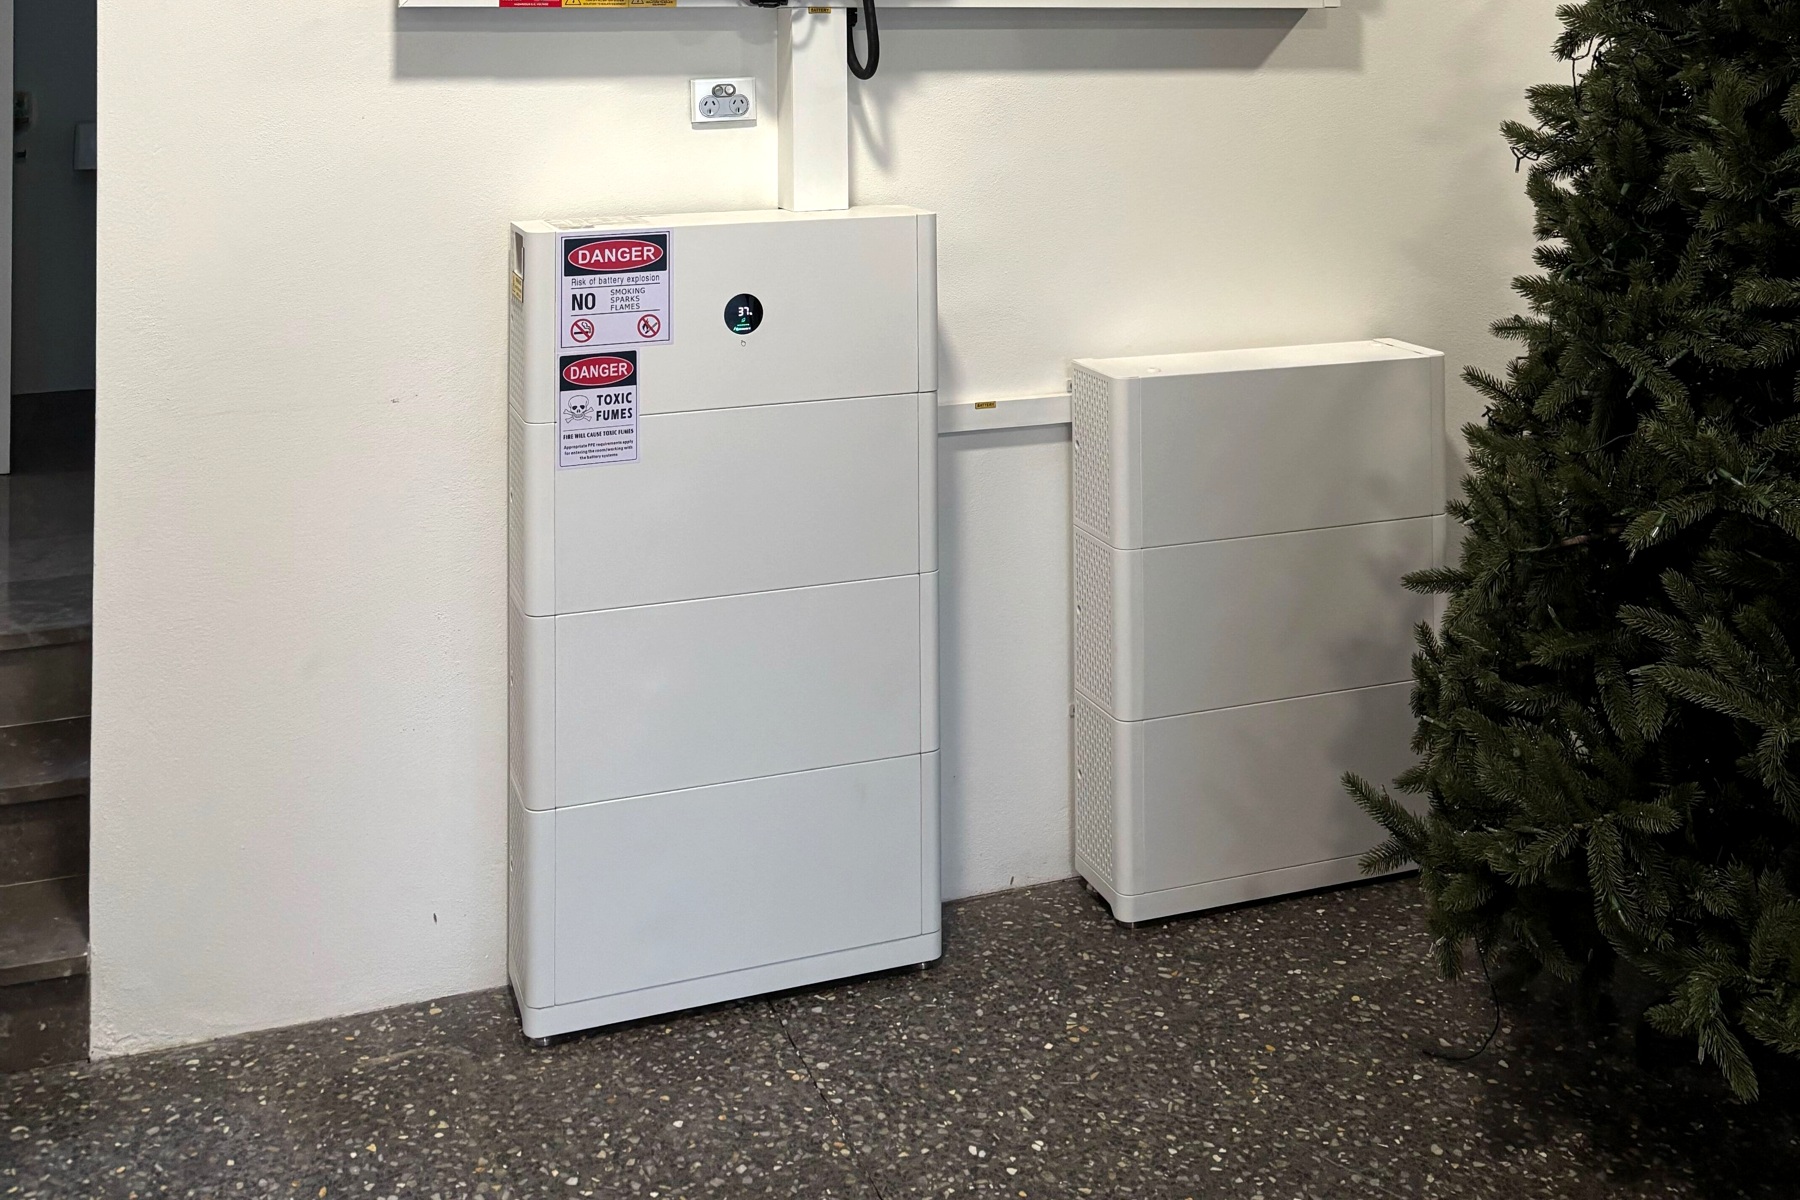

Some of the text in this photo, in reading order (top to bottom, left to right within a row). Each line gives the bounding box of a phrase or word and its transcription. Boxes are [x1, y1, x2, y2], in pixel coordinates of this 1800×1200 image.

[578, 246, 655, 264] DANGER
[571, 274, 660, 286] Risk of battery explosion
[571, 287, 645, 311] NO SMOKING
[610, 295, 640, 303] SPARKS
[610, 303, 640, 311] FLAMES
[570, 362, 628, 380] DANGER
[597, 392, 632, 406] TOXIC
[596, 408, 632, 421] FUMES
